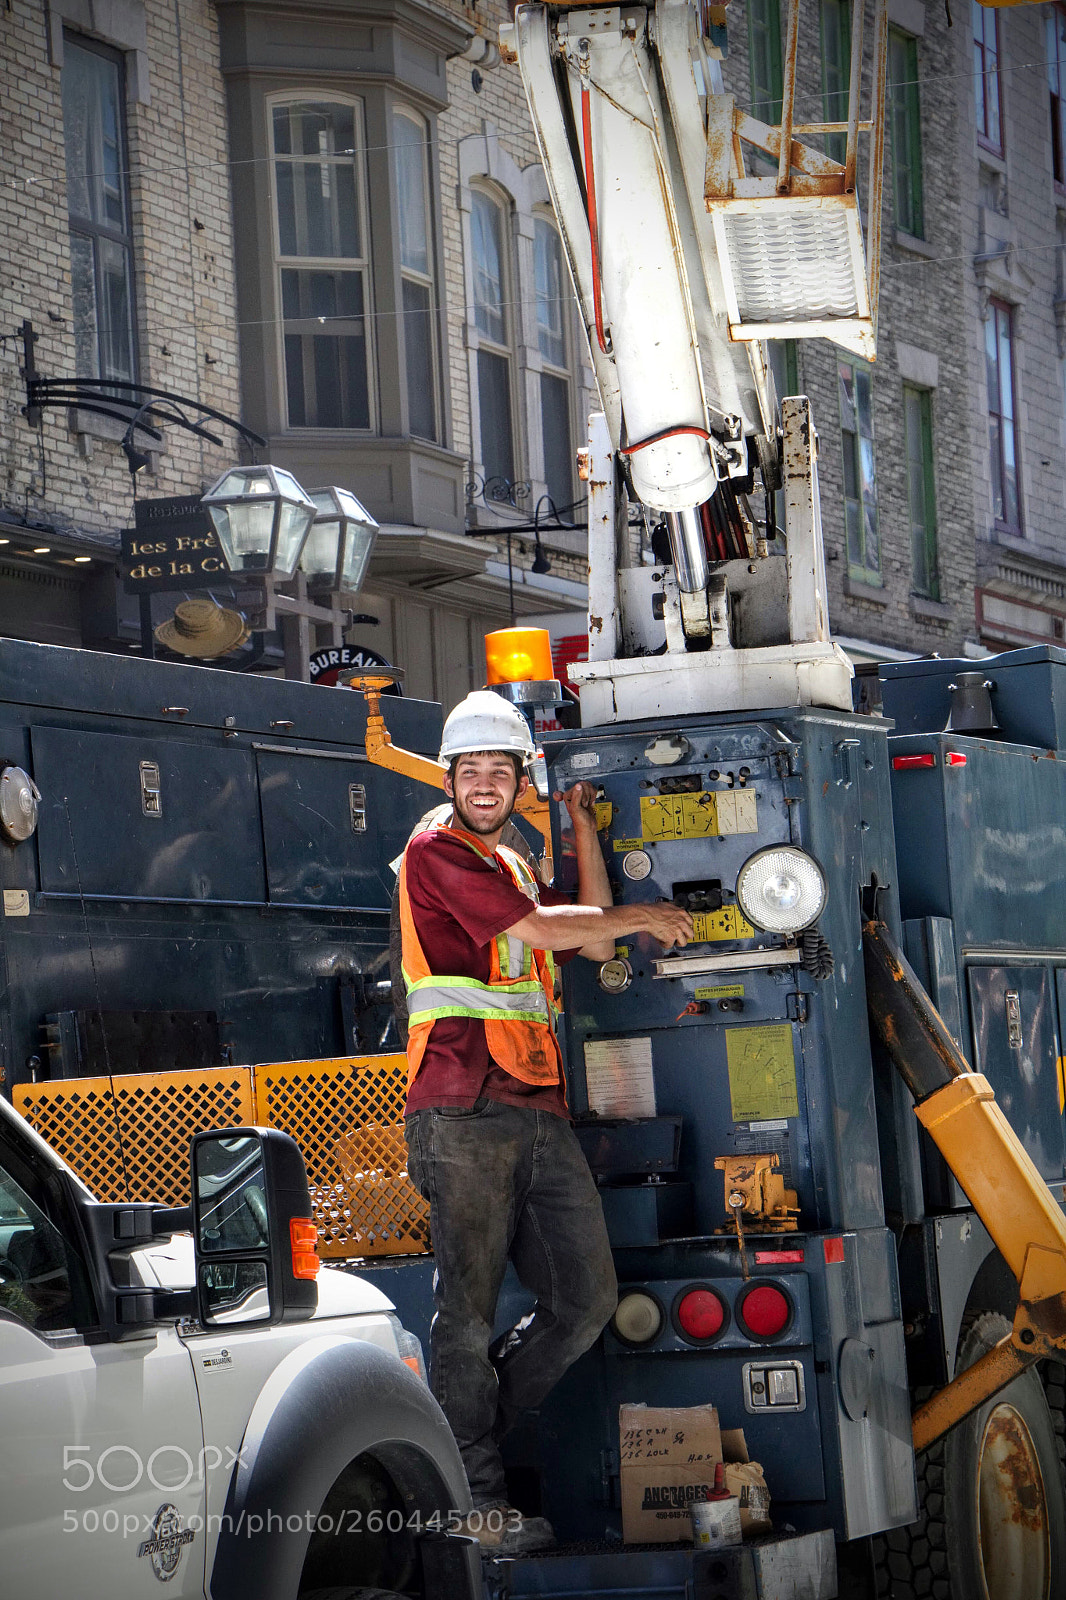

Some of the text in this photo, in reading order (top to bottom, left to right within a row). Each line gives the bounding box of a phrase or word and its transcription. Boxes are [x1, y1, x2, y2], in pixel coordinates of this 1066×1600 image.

[130, 540, 168, 556] les
[130, 564, 162, 579] de
[169, 560, 195, 576] la
[644, 1485, 709, 1502] ANCRAGES
